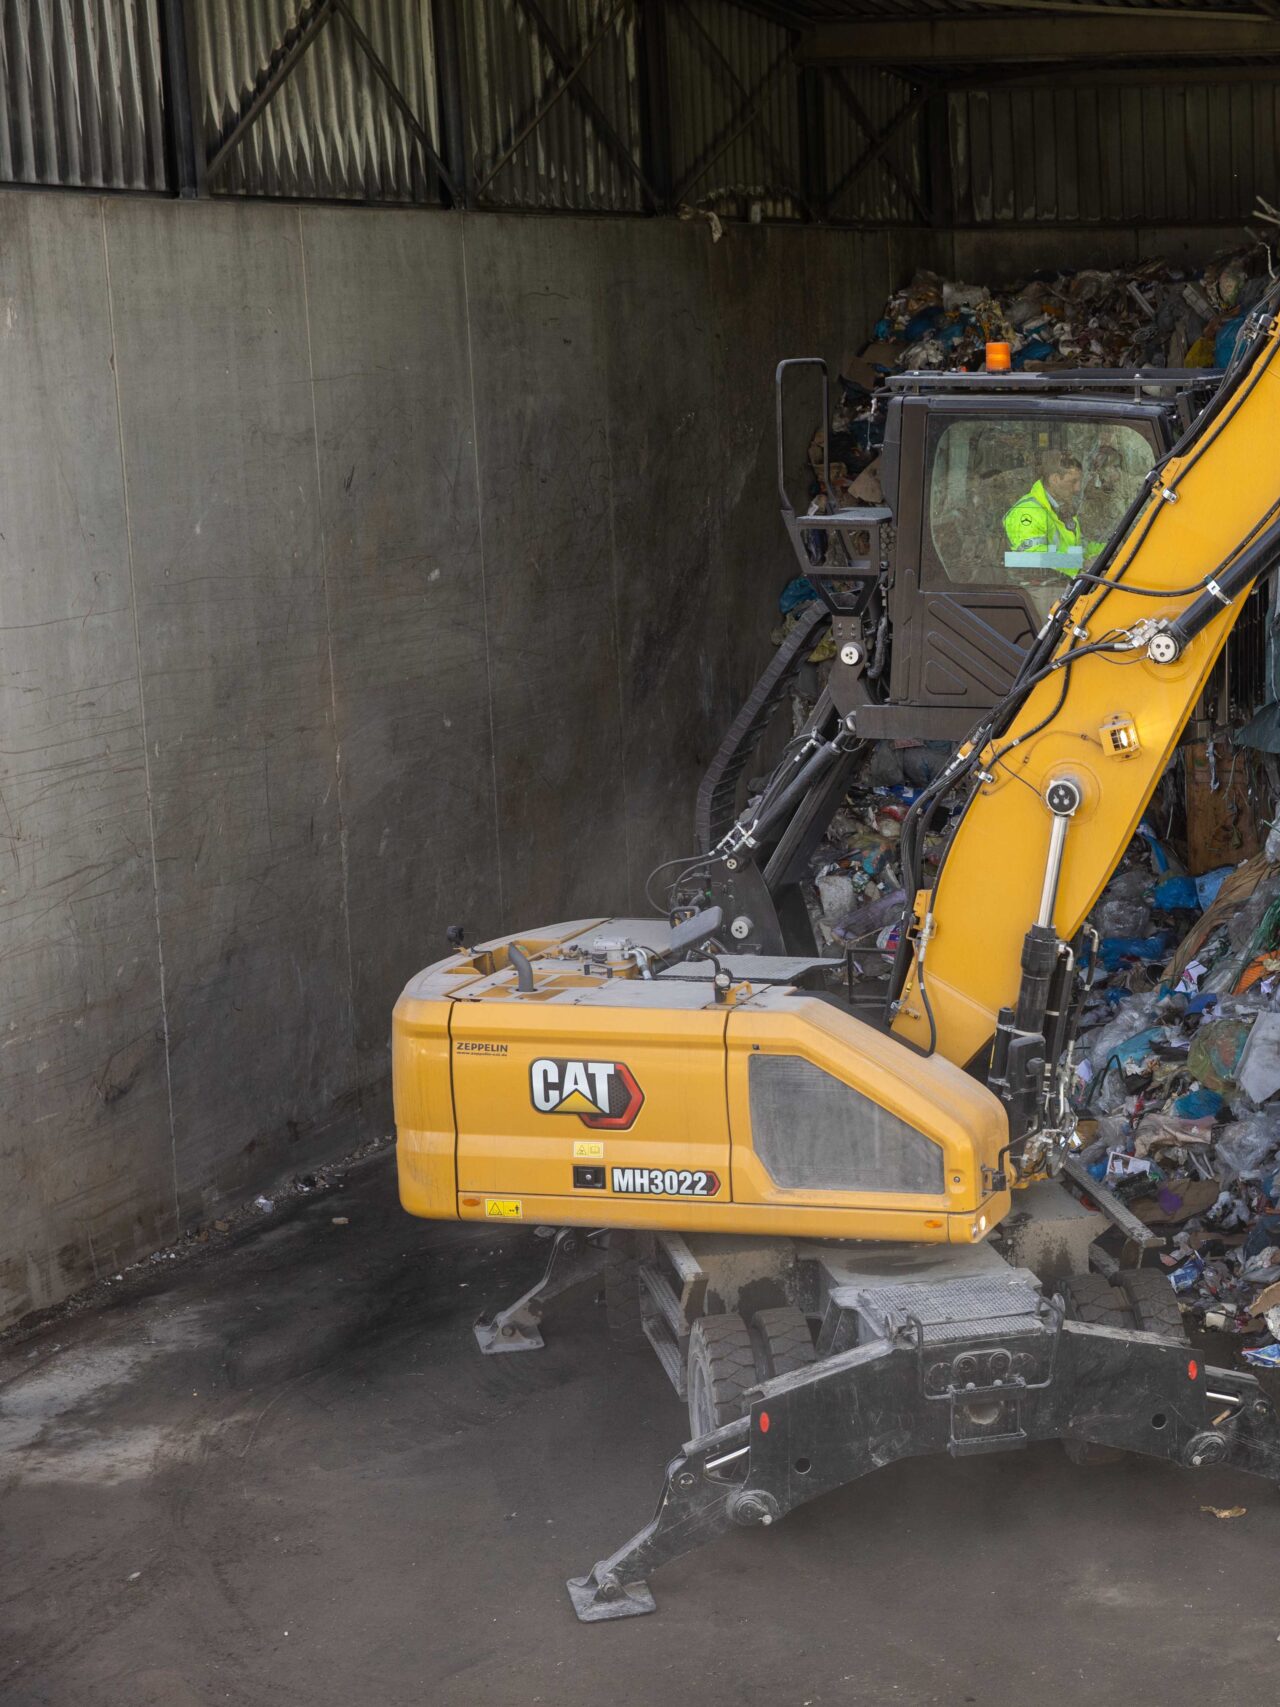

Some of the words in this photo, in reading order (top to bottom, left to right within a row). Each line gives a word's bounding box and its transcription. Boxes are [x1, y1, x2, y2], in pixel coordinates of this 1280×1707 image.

[456, 1042, 508, 1053] ZEPPELIN
[531, 1059, 615, 1114] CAT
[612, 1168, 708, 1196] MH3022
